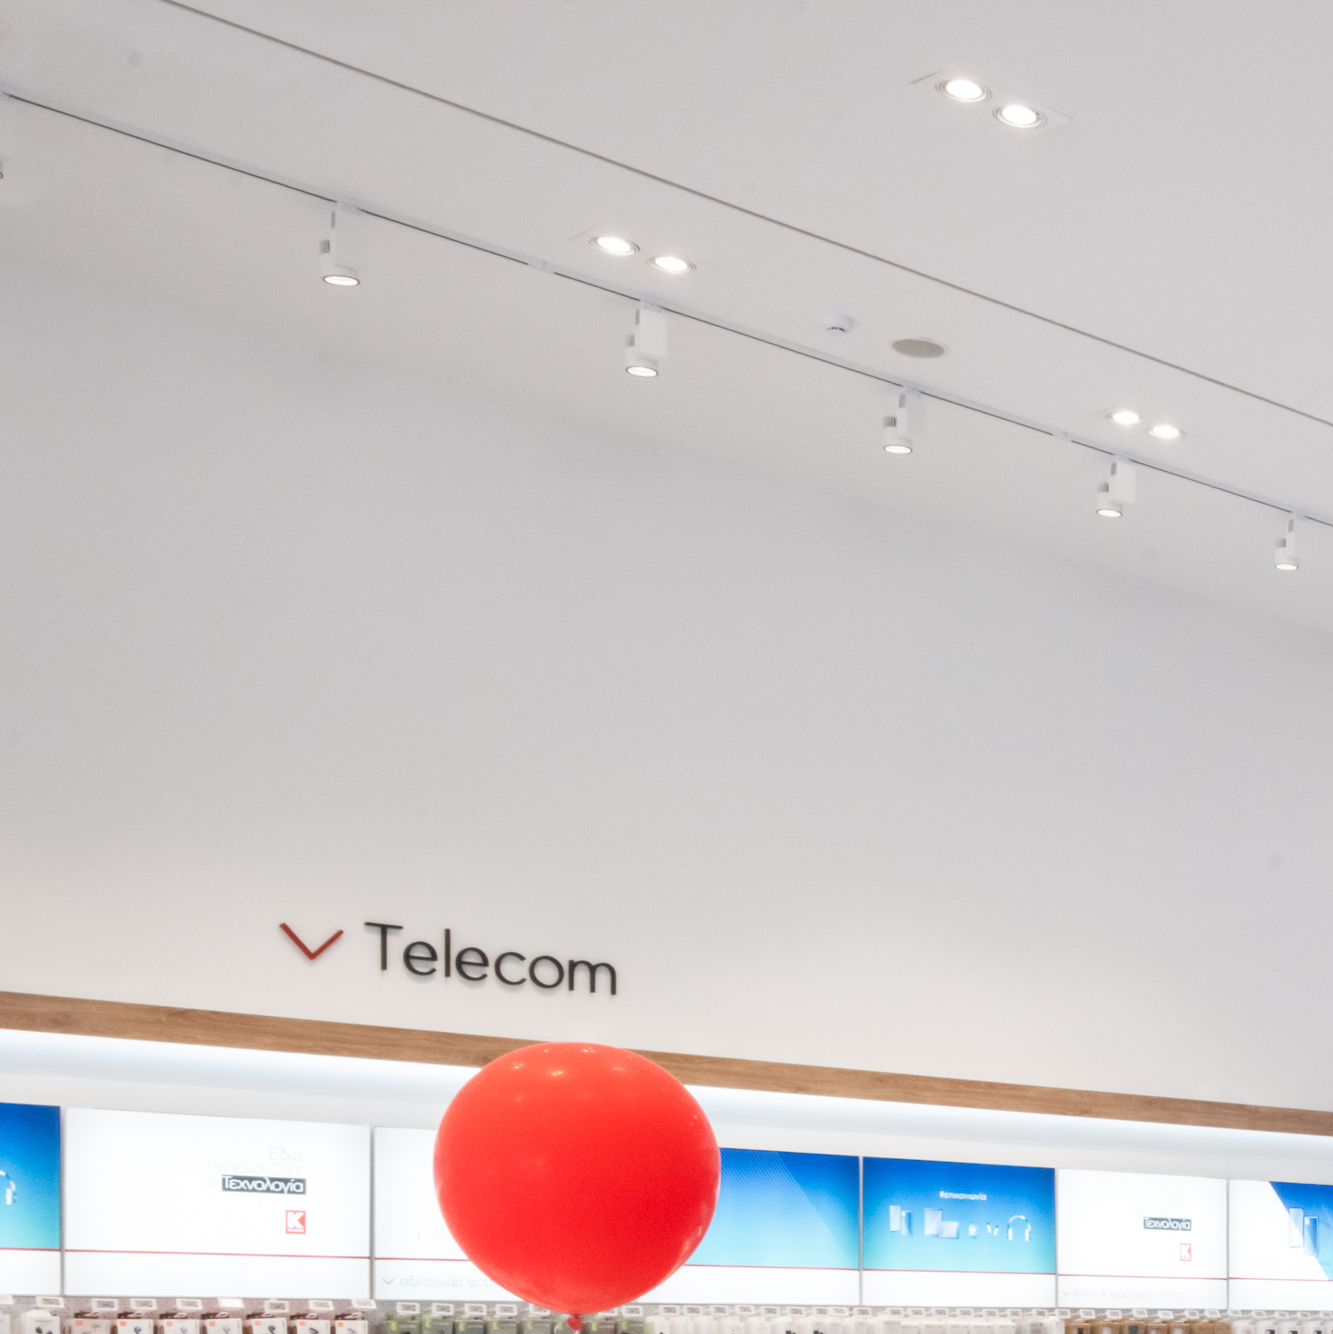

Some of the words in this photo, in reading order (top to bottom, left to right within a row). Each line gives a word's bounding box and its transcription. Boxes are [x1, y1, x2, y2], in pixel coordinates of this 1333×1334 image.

[364, 921, 618, 996] Telecom
[222, 1175, 305, 1194] Τεχνολογία
[286, 1211, 305, 1231] K
[1144, 1217, 1191, 1231] Τεχνολογία
